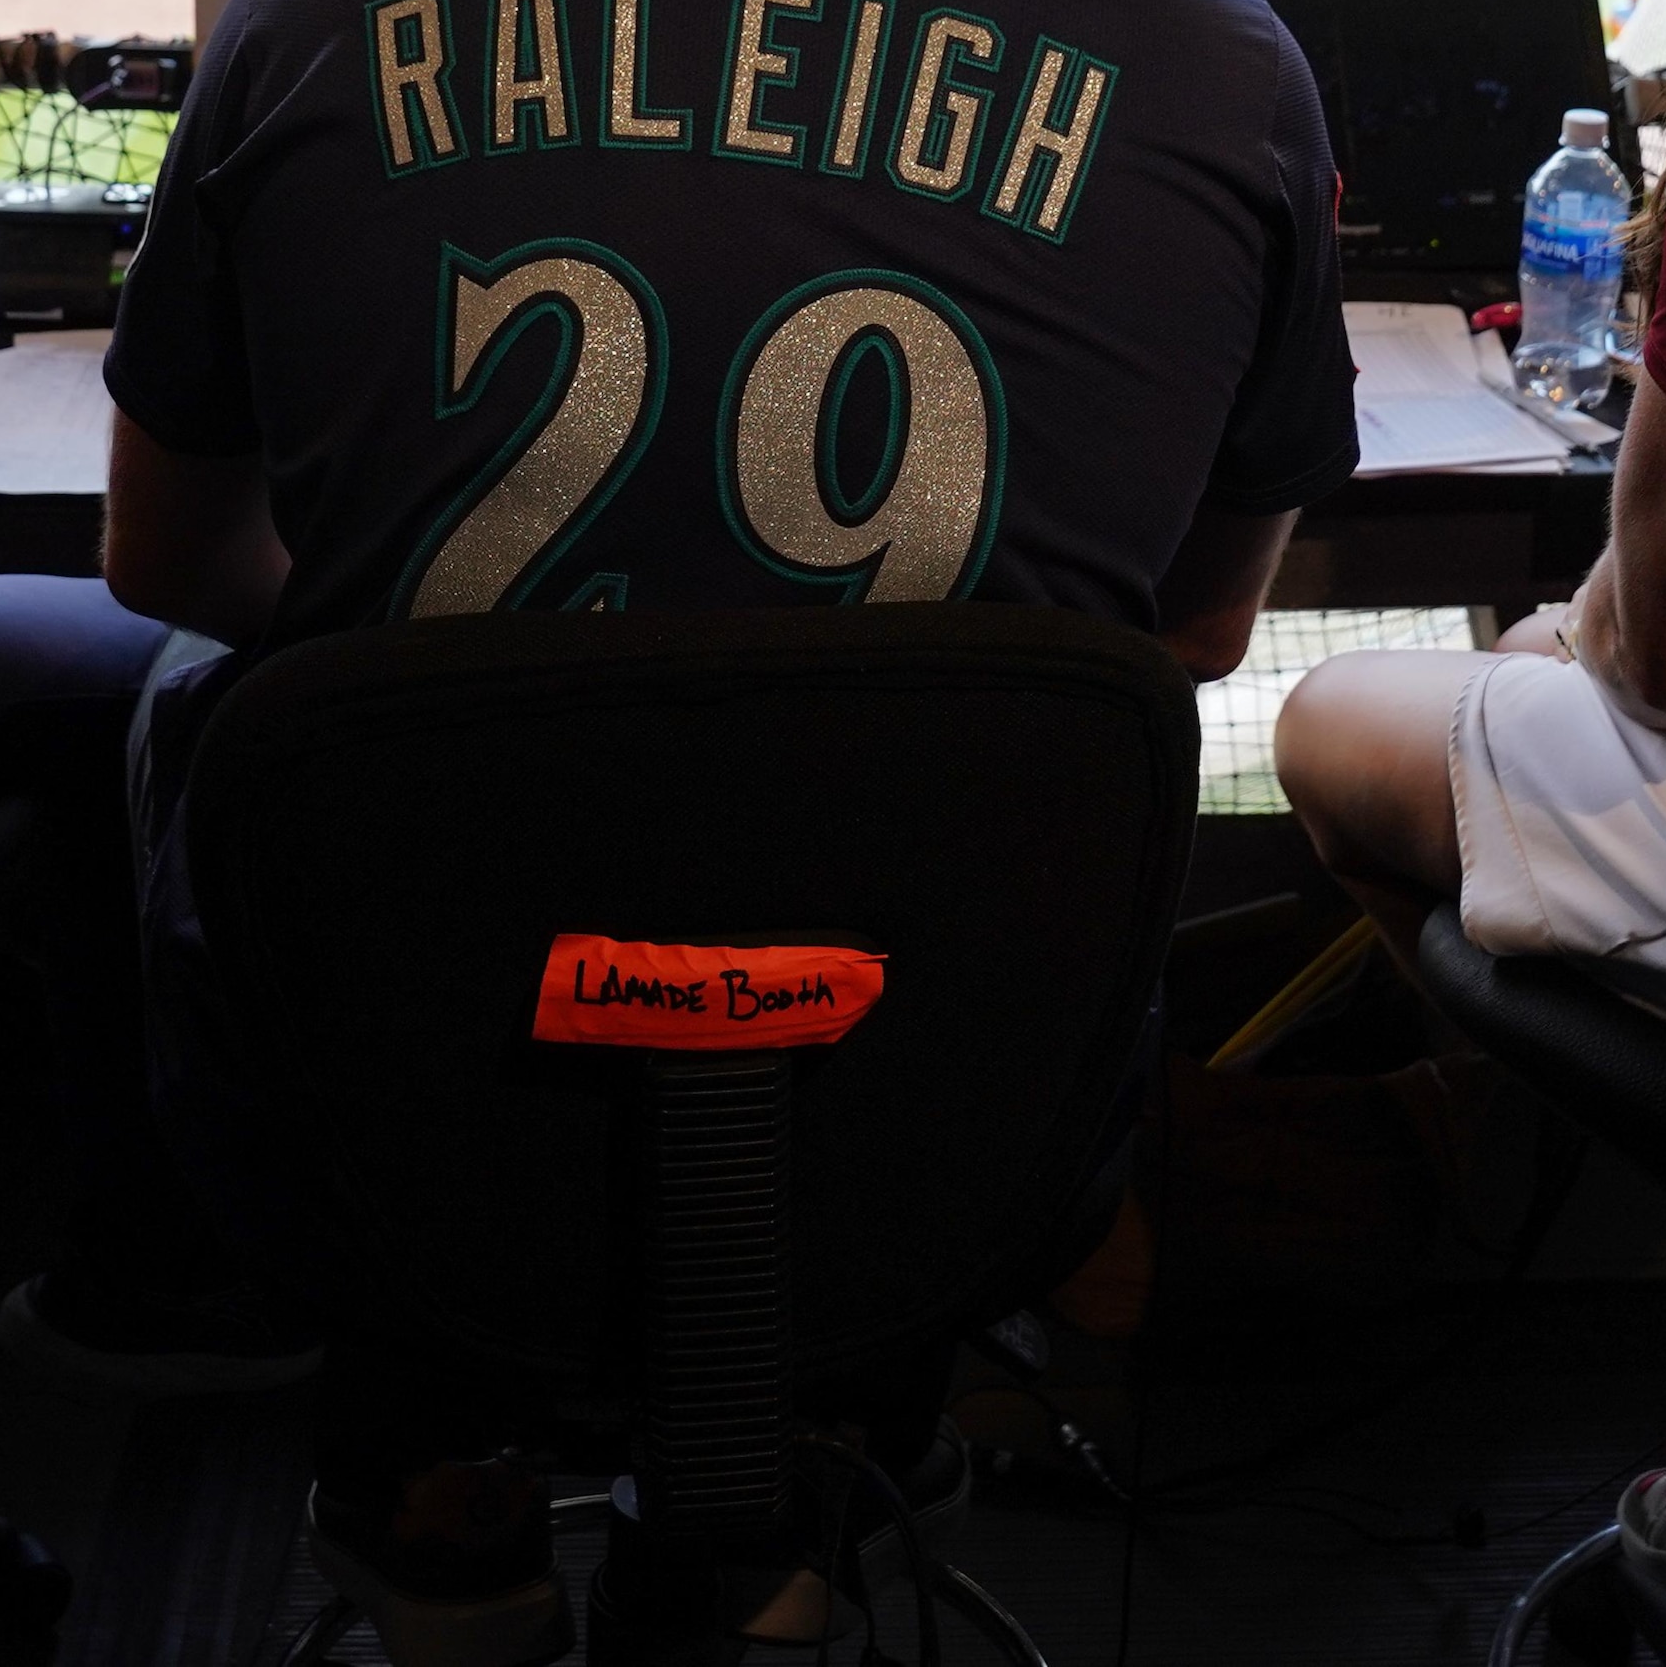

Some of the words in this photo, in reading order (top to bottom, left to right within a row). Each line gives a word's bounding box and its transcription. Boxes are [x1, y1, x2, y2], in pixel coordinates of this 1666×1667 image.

[388, 237, 1008, 617] 29
[574, 958, 708, 1014] LAMADE
[720, 968, 835, 1022] Booth
